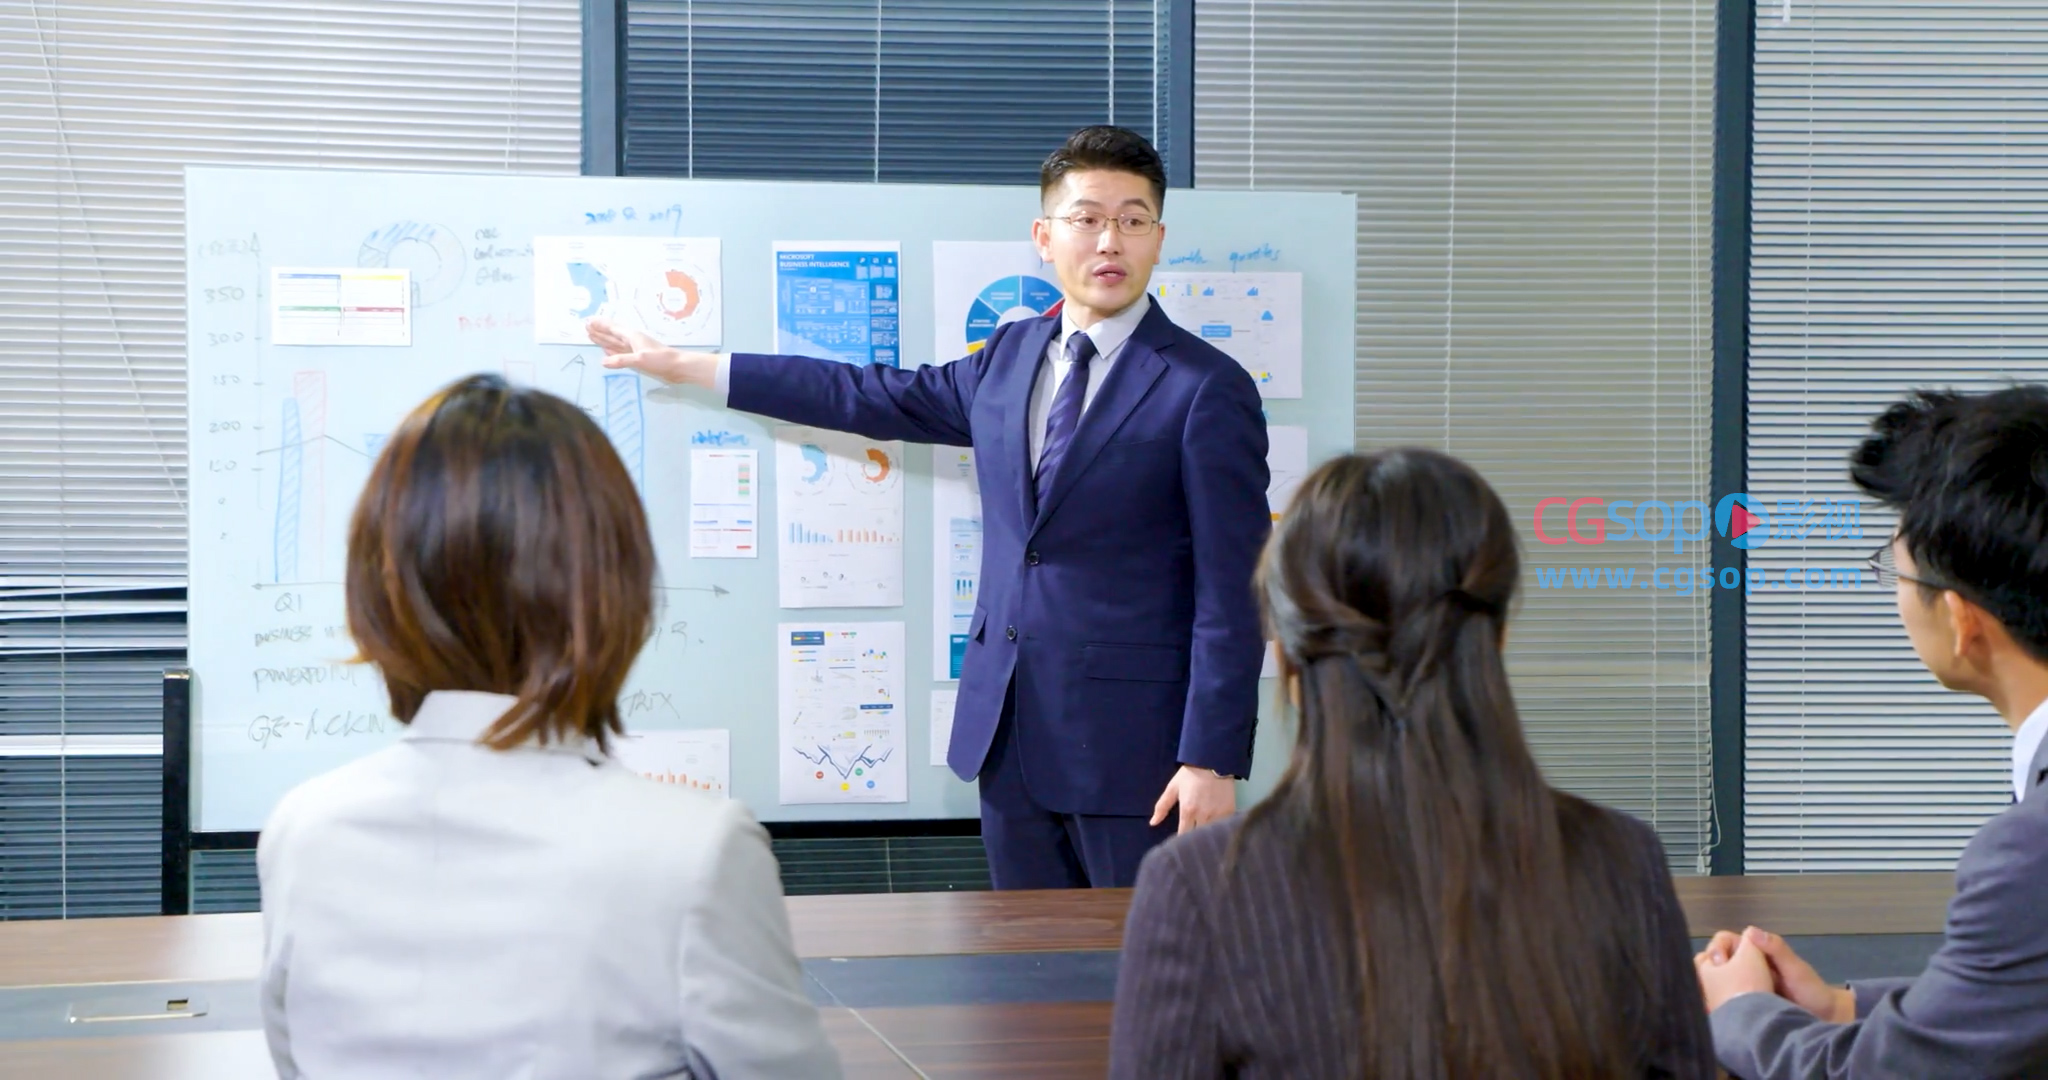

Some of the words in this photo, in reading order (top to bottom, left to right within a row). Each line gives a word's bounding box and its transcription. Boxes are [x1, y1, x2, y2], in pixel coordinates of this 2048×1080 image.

[779, 260, 808, 268] BUSINESS
[203, 285, 245, 304] 350
[207, 331, 245, 347] 300
[208, 420, 242, 433] 200
[274, 592, 302, 613] Q1
